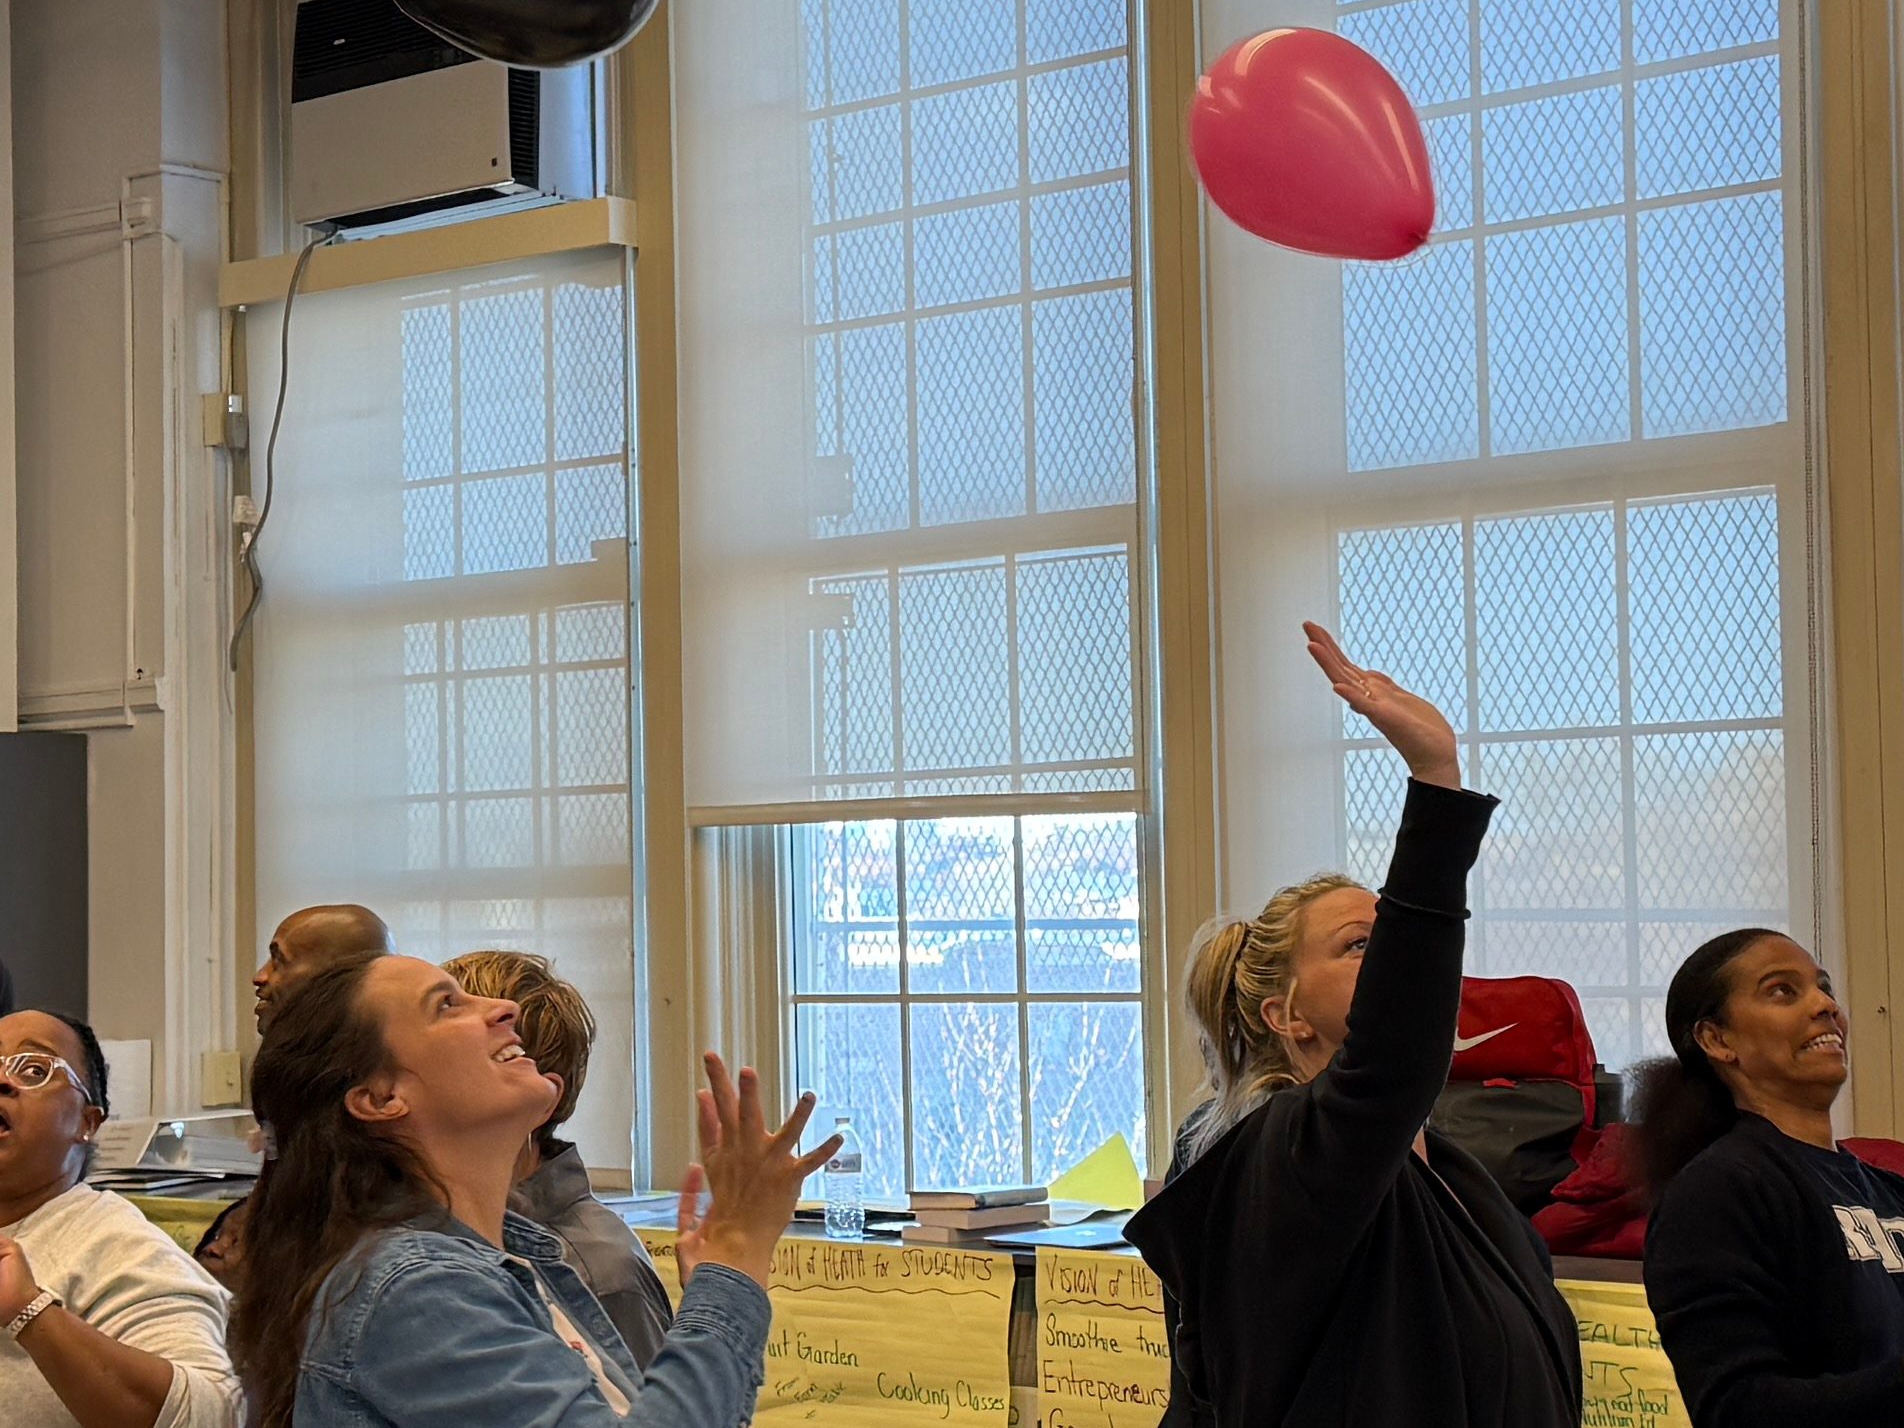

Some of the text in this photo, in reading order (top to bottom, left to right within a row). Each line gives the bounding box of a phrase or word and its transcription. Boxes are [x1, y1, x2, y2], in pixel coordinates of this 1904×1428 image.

[873, 1253, 890, 1278] for
[901, 1247, 994, 1282] STUDENTS
[1130, 1263, 1162, 1301] HE
[796, 1331, 860, 1368] Garden
[877, 1371, 1006, 1419] Cooking Classes
